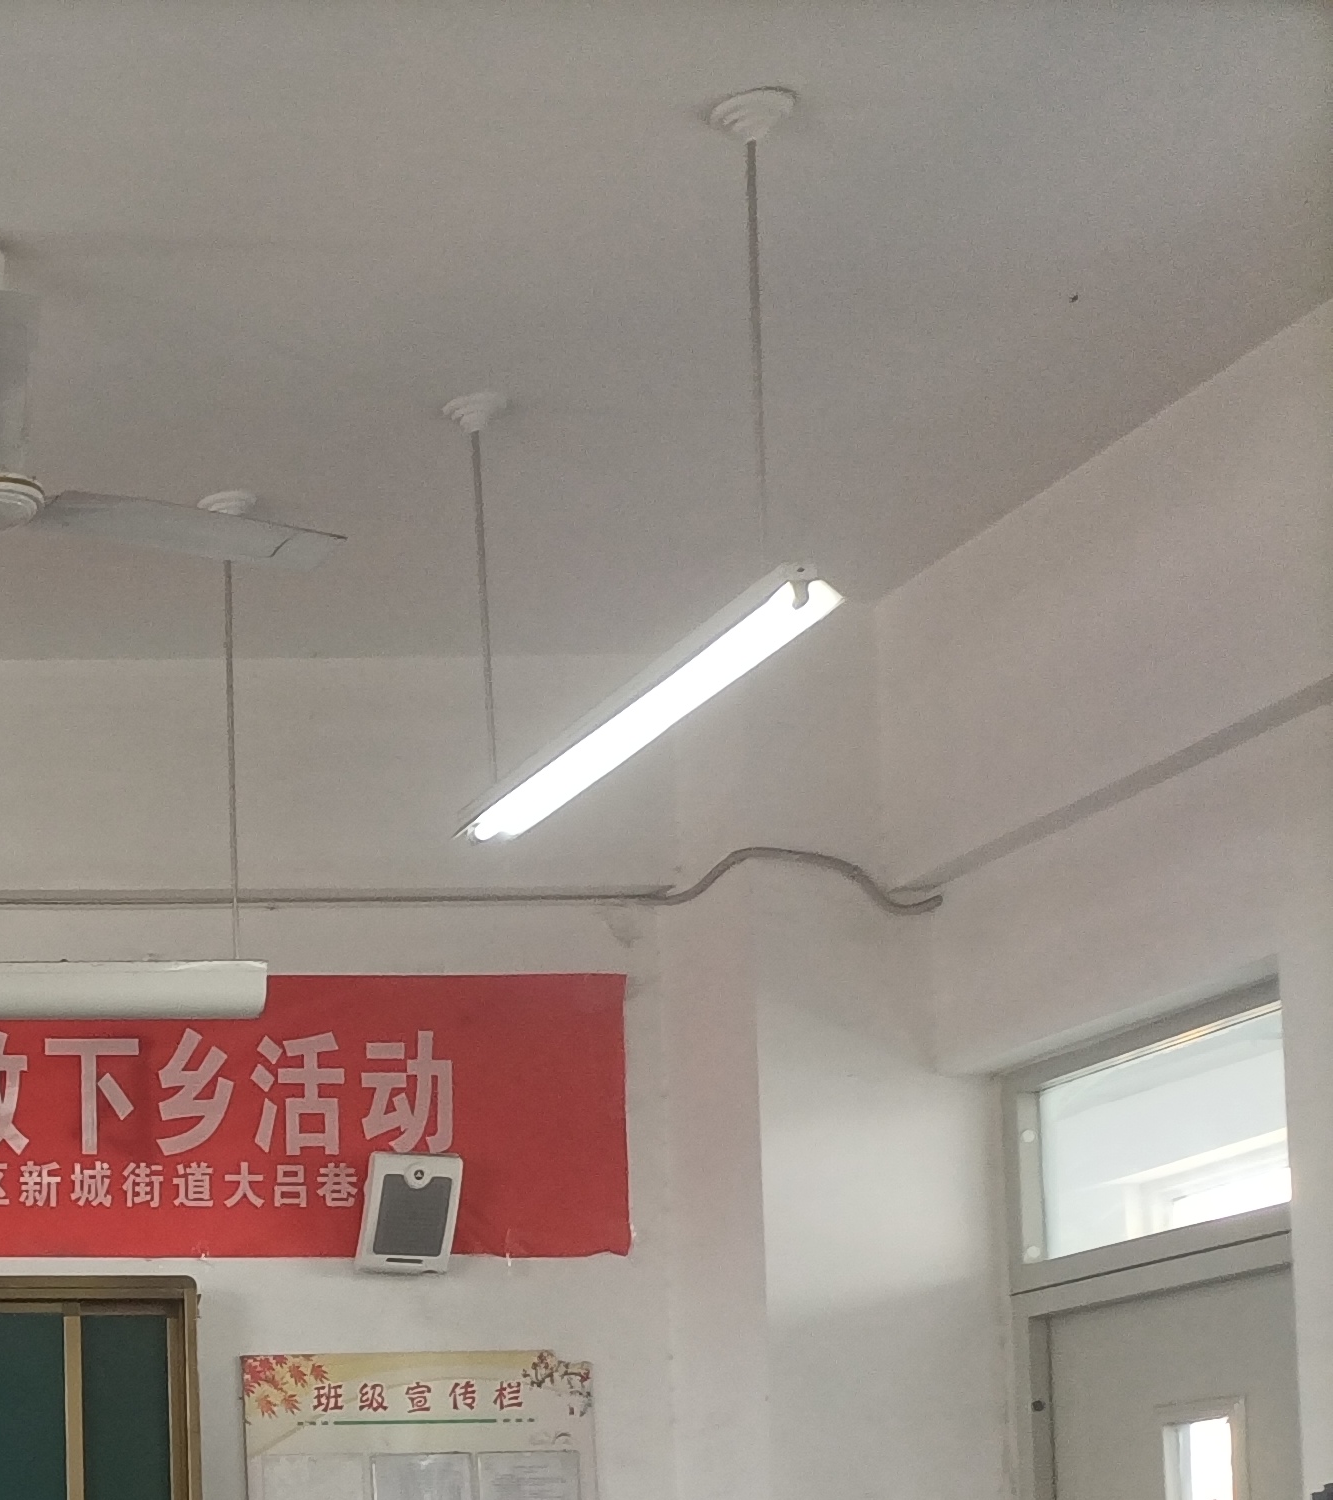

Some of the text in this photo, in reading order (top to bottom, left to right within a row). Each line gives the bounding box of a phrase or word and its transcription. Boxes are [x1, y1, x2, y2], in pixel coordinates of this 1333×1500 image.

[312, 1380, 525, 1414] 班级宣传栏
